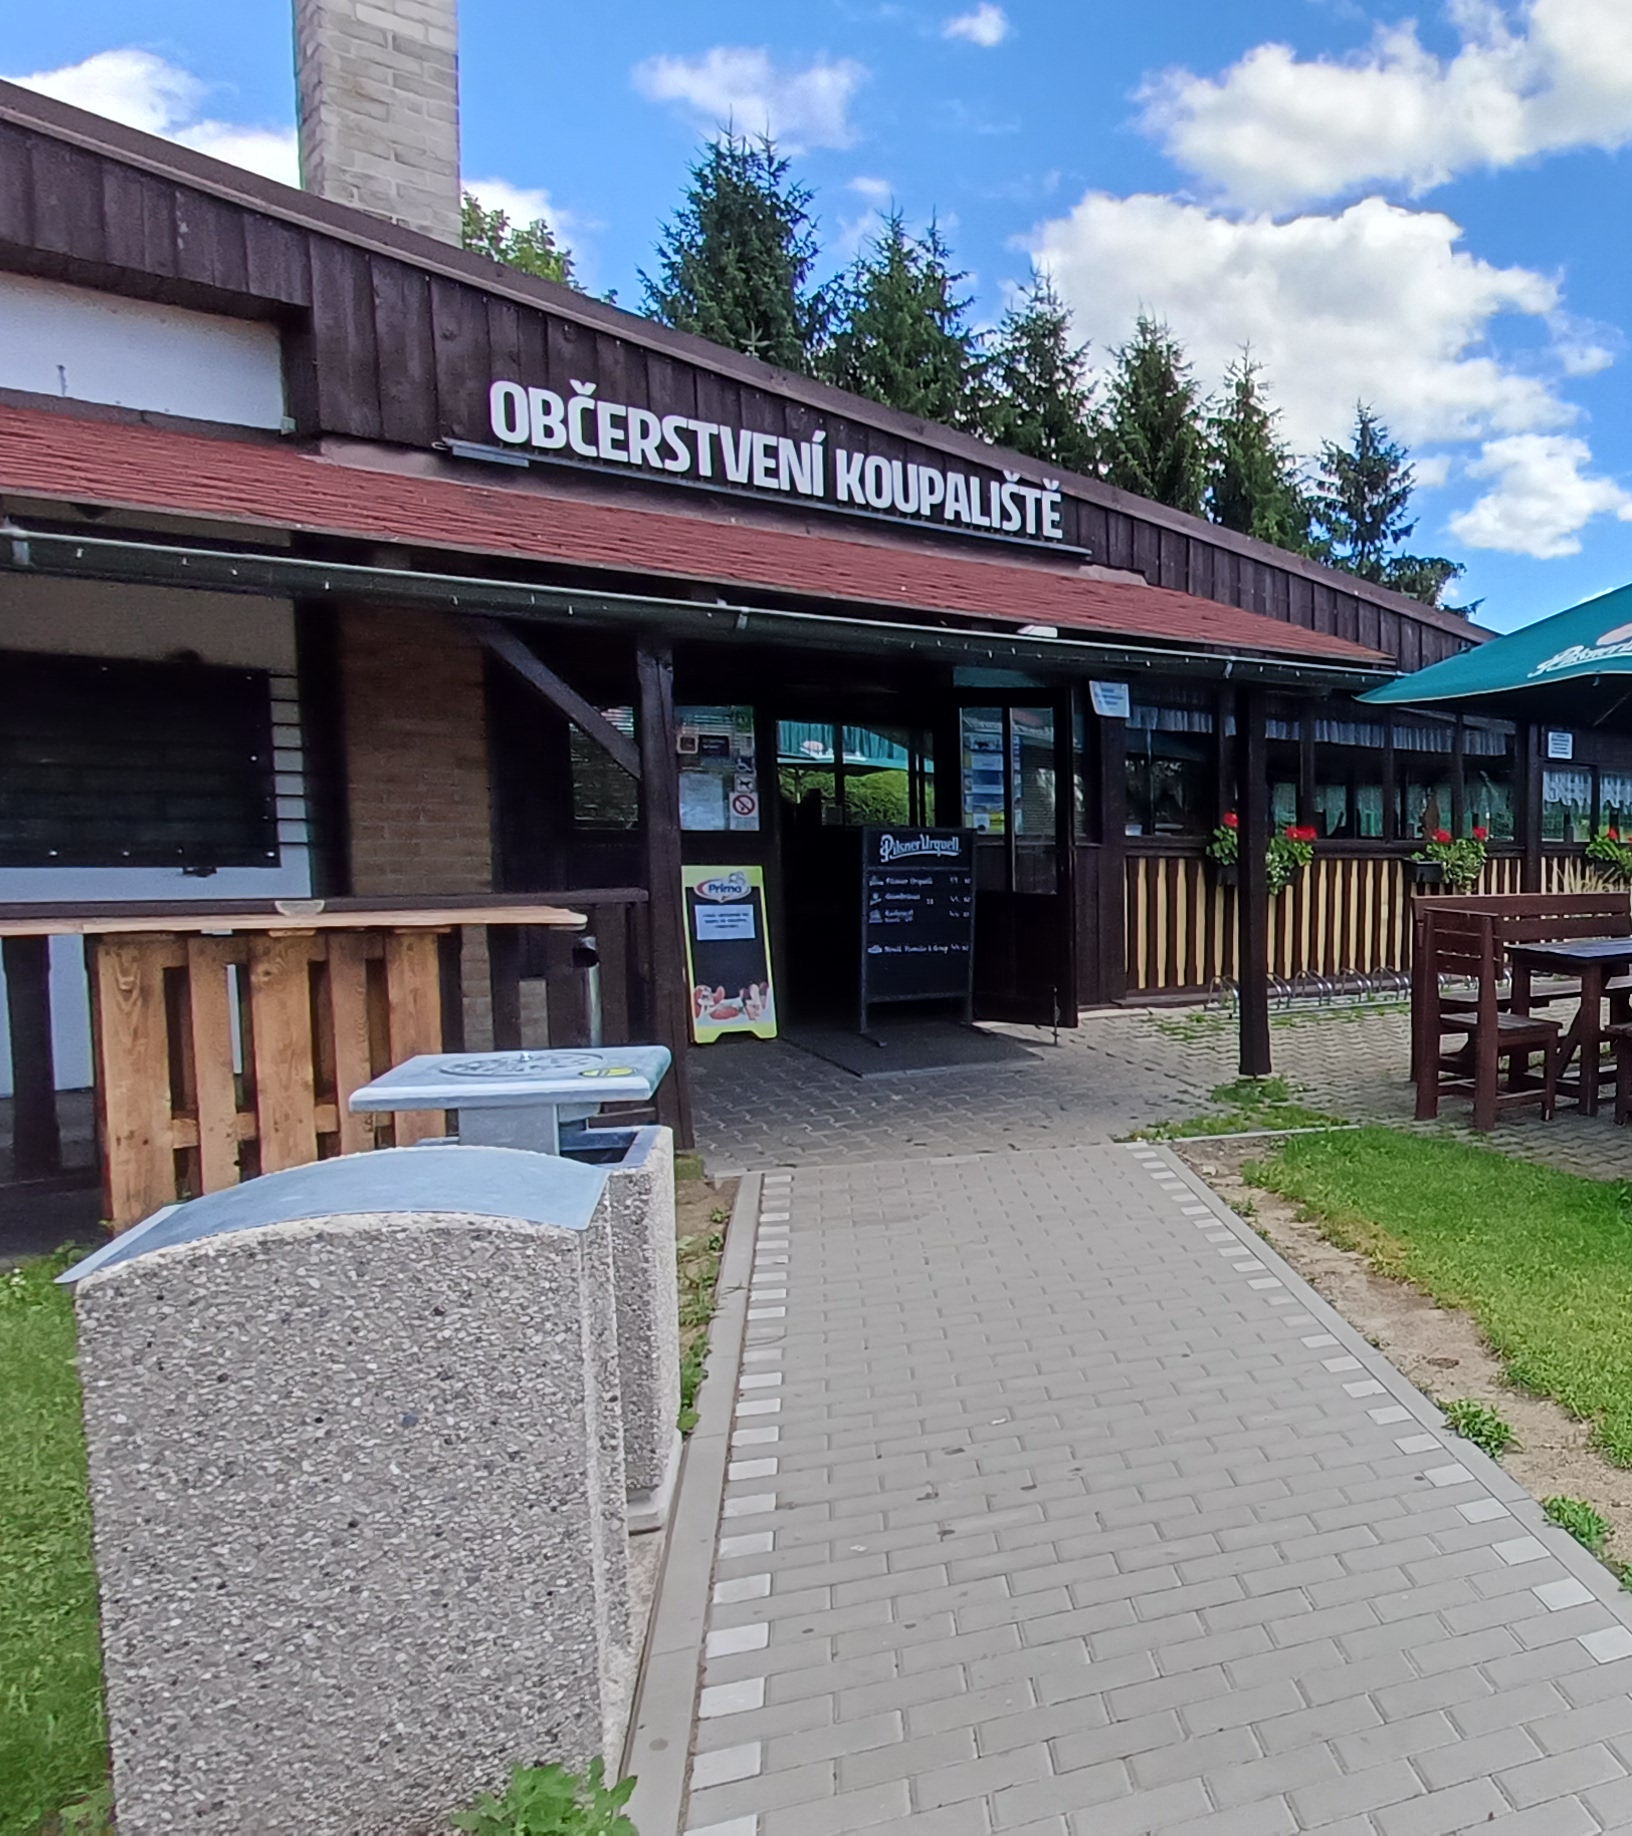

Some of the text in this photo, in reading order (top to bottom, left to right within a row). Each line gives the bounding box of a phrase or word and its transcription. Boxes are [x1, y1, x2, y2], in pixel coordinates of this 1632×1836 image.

[489, 379, 1063, 541] OBČERSTVENÍ KOUPALIŠTĚ
[879, 833, 960, 863] Pilsner Urquell
[708, 882, 743, 894] Prima
